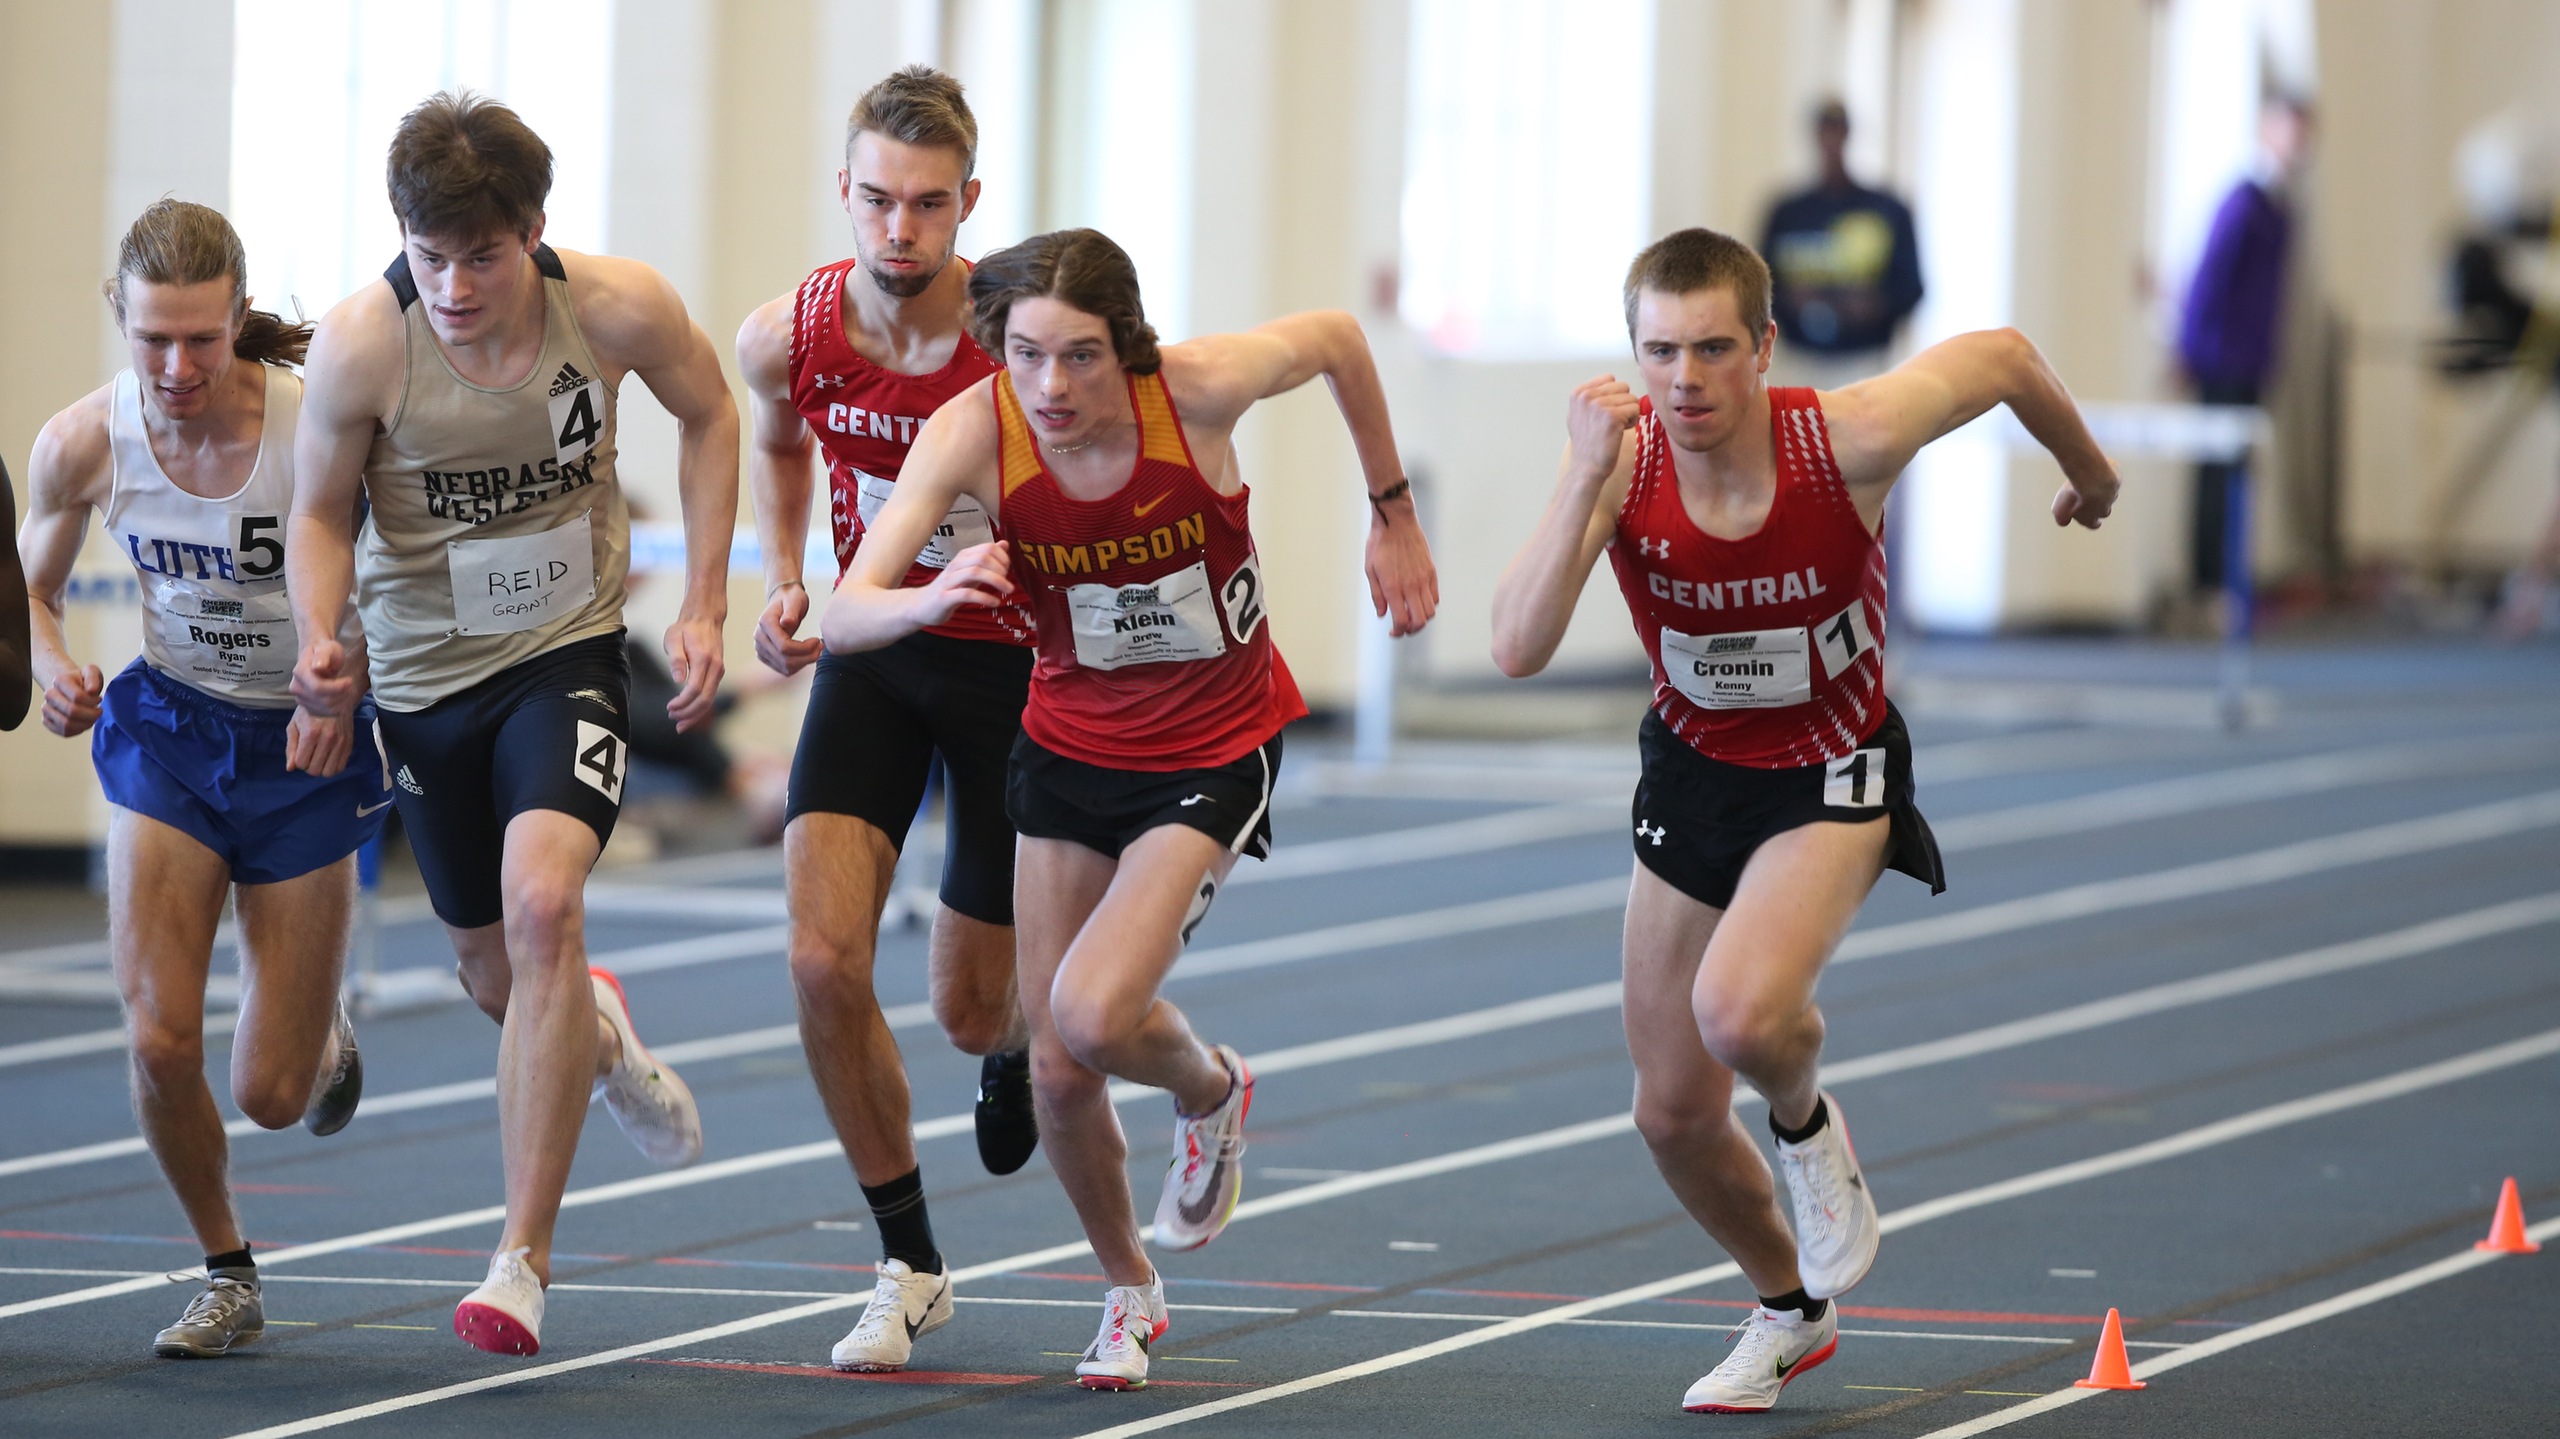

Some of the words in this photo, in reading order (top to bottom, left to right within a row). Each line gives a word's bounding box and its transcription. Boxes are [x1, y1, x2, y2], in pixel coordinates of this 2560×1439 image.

[549, 375, 589, 397] adidas
[558, 387, 602, 449] 4
[827, 402, 929, 445] CENT
[239, 516, 285, 576] 5
[1017, 511, 1205, 575] SIMPSON
[128, 534, 286, 585] LUTH
[488, 560, 568, 596] REID
[1119, 584, 1160, 597] AMERICAN
[1648, 565, 1827, 611] CENTRAL
[201, 599, 243, 608] AMERICAN
[492, 590, 554, 617] GRANT
[1226, 567, 1261, 640] 2
[1113, 611, 1176, 634] Klein
[1825, 609, 1858, 661] 1
[188, 624, 271, 650] Rogers
[1132, 632, 1163, 644] Drew
[1711, 635, 1757, 643] AMERICAN
[218, 651, 247, 663] Ryan
[1693, 659, 1774, 677] Cronin
[192, 665, 213, 673] Hosted
[222, 668, 250, 678] University
[1715, 681, 1752, 692] Kenny
[579, 733, 619, 793] 4
[396, 775, 424, 796] adidas
[1835, 753, 1868, 805] 1
